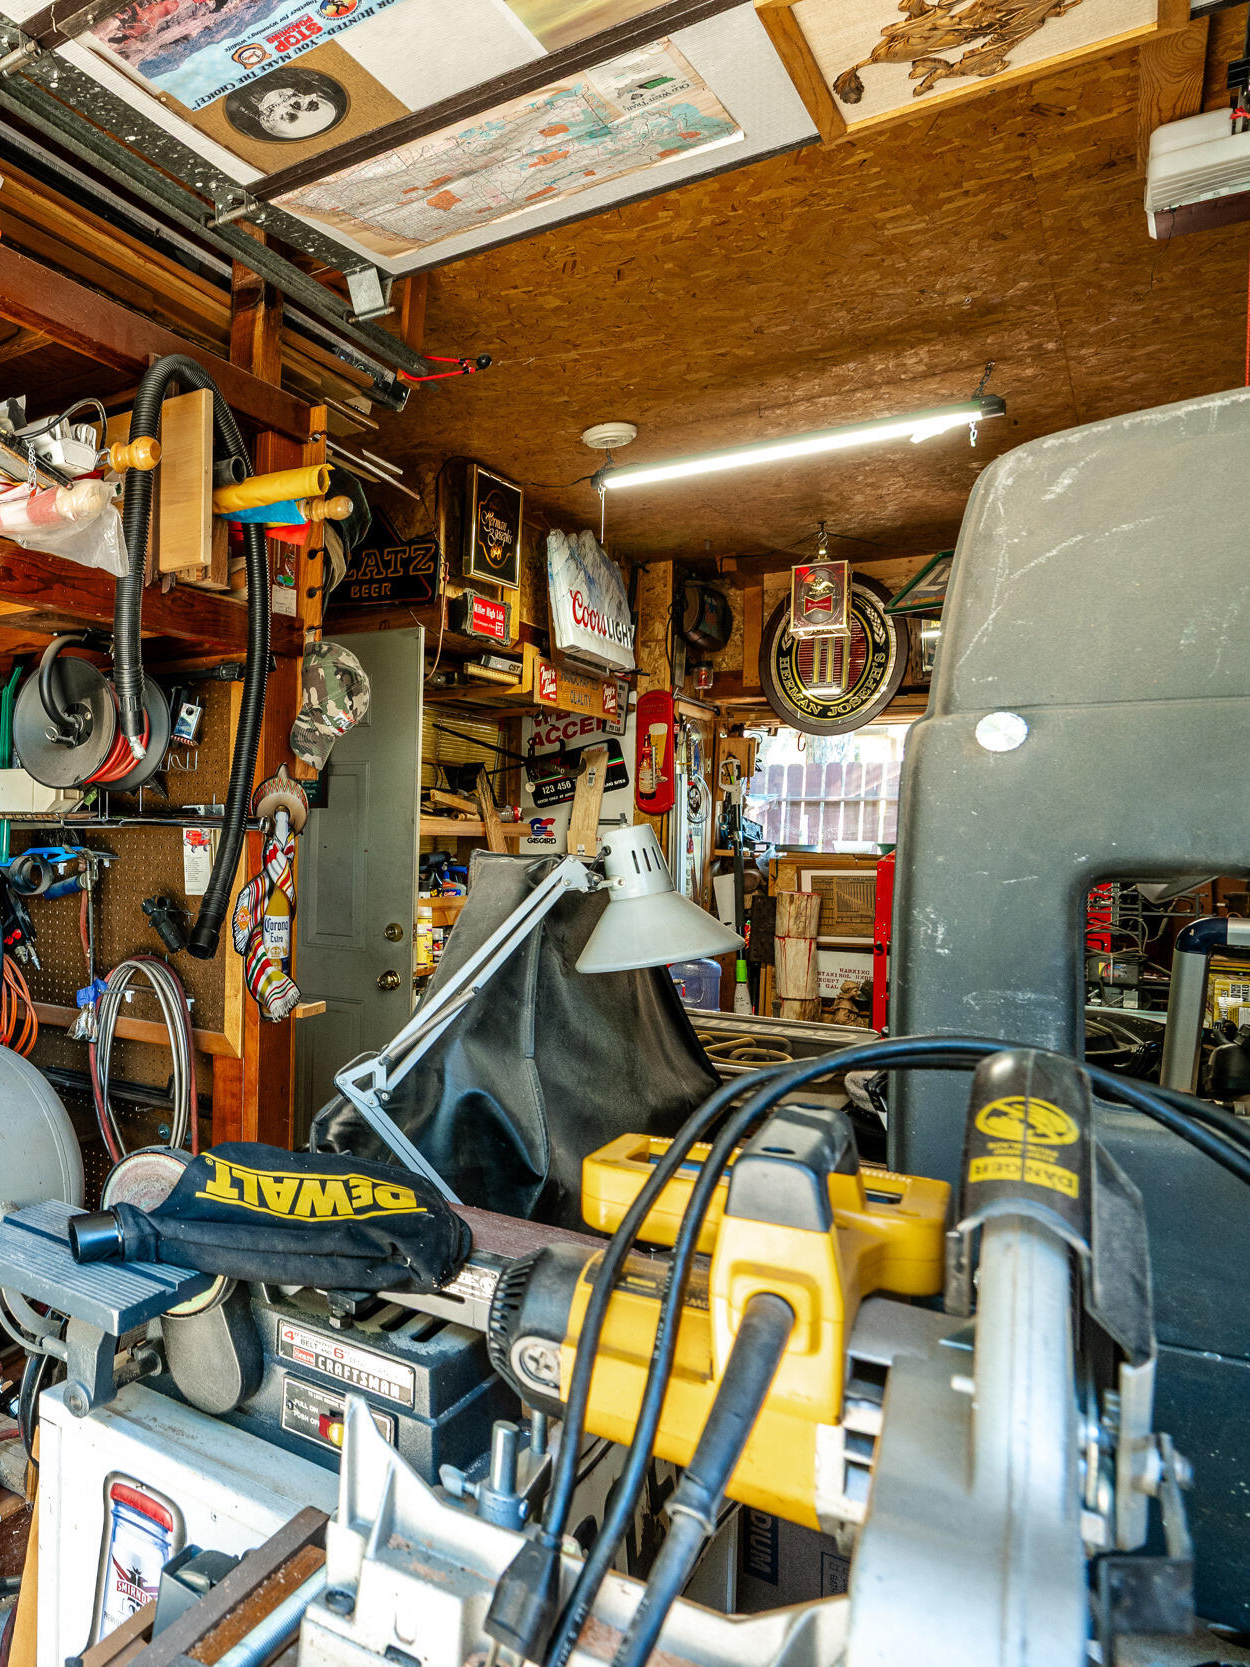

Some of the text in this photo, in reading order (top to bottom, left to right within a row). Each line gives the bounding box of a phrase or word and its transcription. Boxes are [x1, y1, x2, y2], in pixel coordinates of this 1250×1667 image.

[248, 20, 279, 40] Wyoming's
[266, 15, 315, 44] POACHING
[275, 22, 323, 53] STOP
[261, 53, 293, 71] MAKE
[238, 71, 259, 85] THE
[351, 583, 391, 598] BEER
[473, 602, 504, 621] Miller High Life
[569, 589, 635, 649] Coors LIGHT
[779, 651, 887, 718] HERMAN JOSEPH'S
[542, 784, 556, 795] 123
[557, 780, 572, 791] 456
[527, 837, 557, 845] GASCARD
[264, 918, 289, 933] Corona
[839, 967, 871, 976] WARNING
[975, 1162, 1073, 1189] DANGER
[206, 1161, 418, 1217] DEWALT
[300, 1338, 318, 1352] BELT
[317, 1356, 401, 1400] CRAFTSMAN
[117, 1580, 152, 1604] SMIRNO
